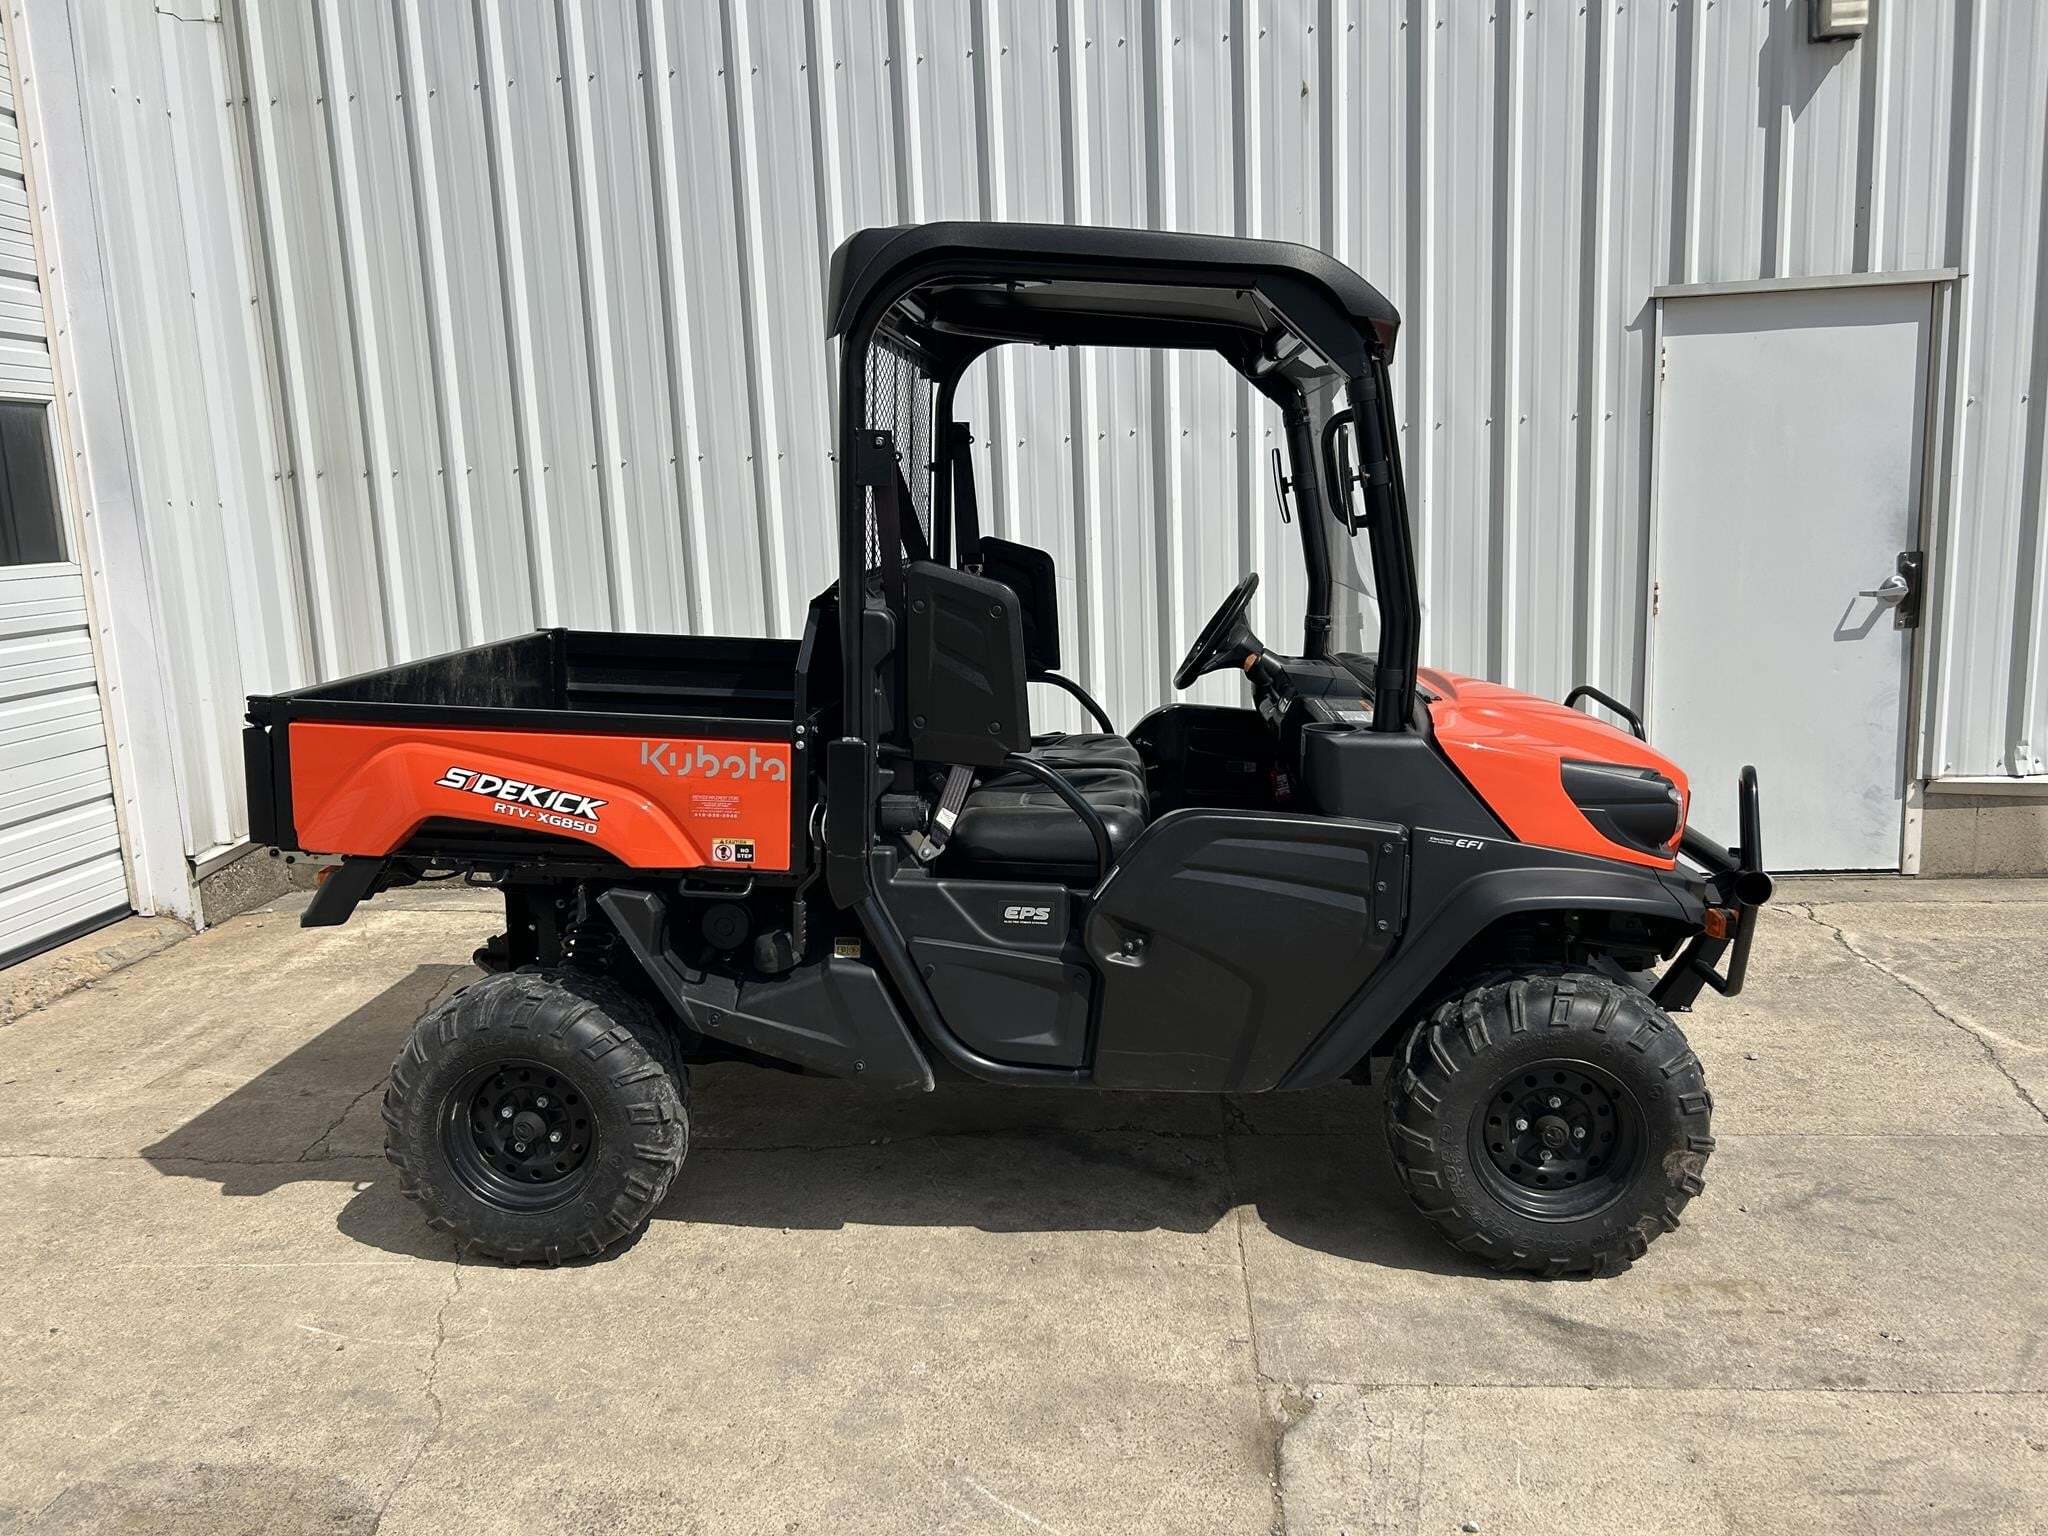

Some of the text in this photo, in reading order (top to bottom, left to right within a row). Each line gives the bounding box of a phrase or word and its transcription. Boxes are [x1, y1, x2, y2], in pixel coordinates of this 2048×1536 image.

[641, 742, 785, 781] Kubota
[436, 767, 608, 820] SIDEKICK
[493, 803, 598, 834] RTV-XG850
[1455, 839, 1484, 850] EFI
[1004, 906, 1051, 920] EPS
